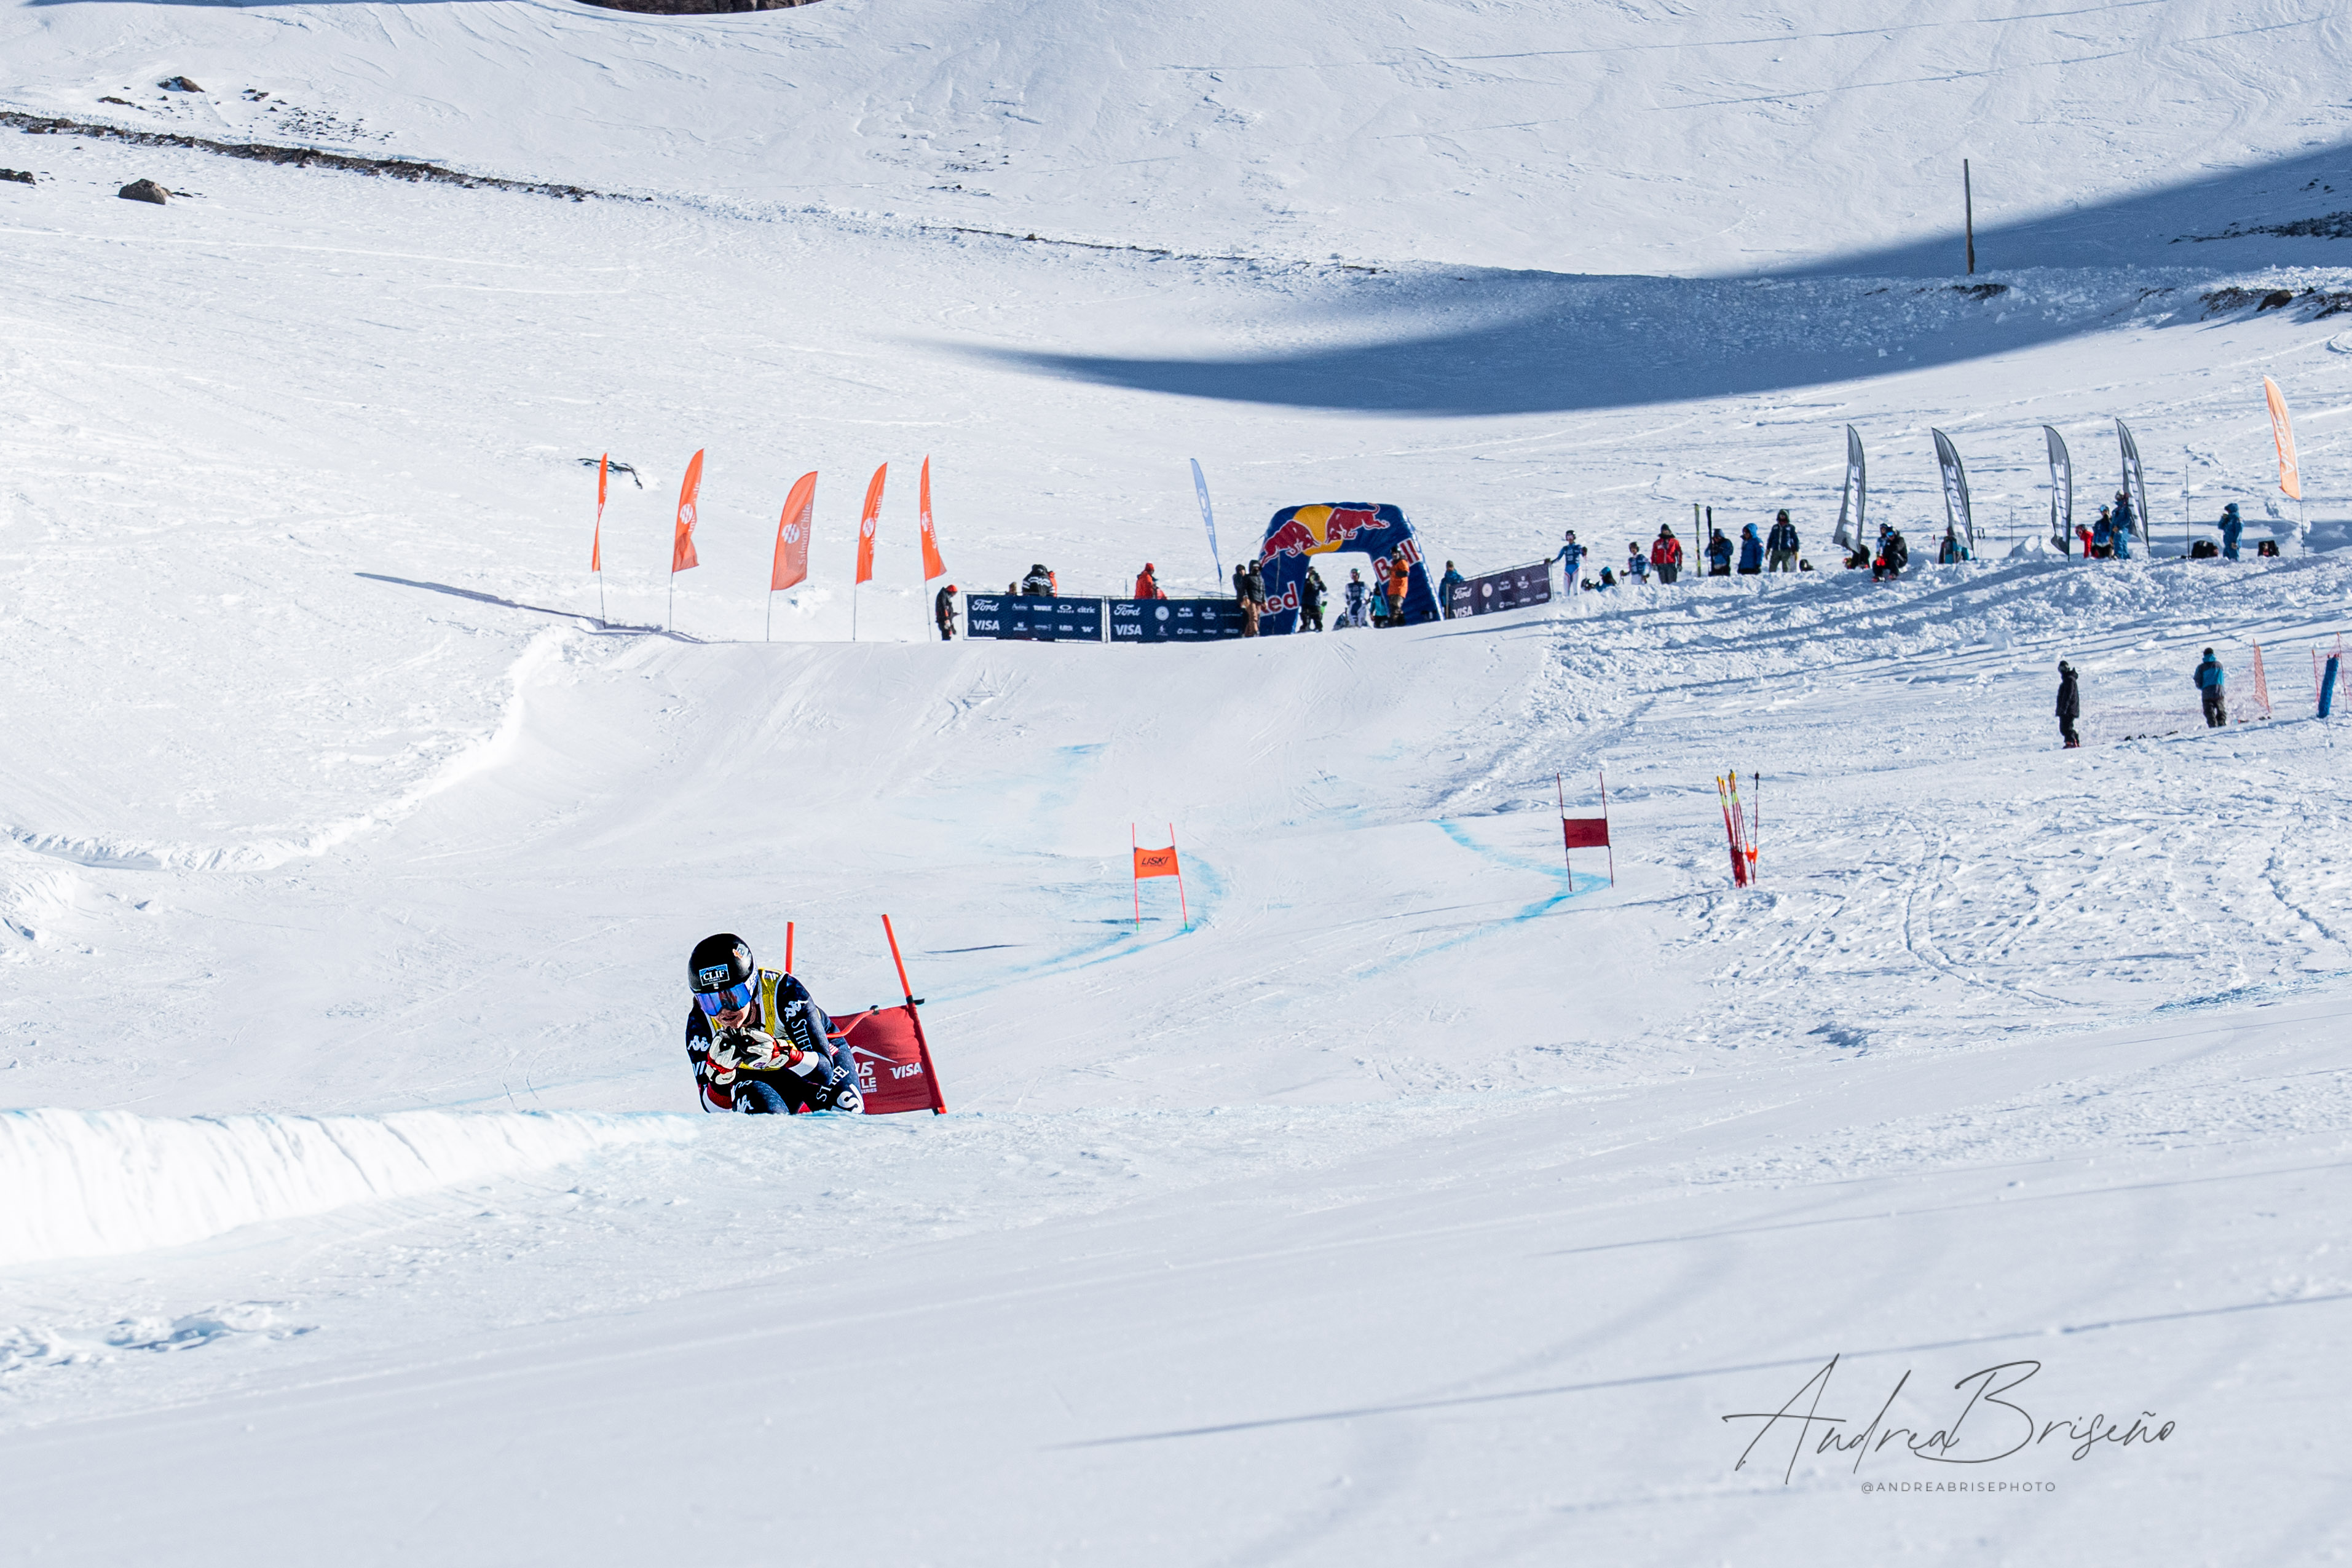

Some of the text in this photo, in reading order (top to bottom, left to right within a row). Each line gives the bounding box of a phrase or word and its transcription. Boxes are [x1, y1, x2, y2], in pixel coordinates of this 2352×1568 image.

[799, 503, 811, 565] SalmonChile
[1372, 538, 1421, 585] Bll
[1260, 581, 1300, 617] ed
[1453, 586, 1472, 600] Ford
[972, 599, 999, 611] Ford
[1114, 604, 1141, 615] Ford
[1453, 605, 1473, 618] VISA
[972, 620, 1000, 630] VISA
[1114, 624, 1142, 635] VISA
[1142, 856, 1170, 865] LISKI
[703, 970, 725, 981] CLIF
[889, 1062, 923, 1079] VISA
